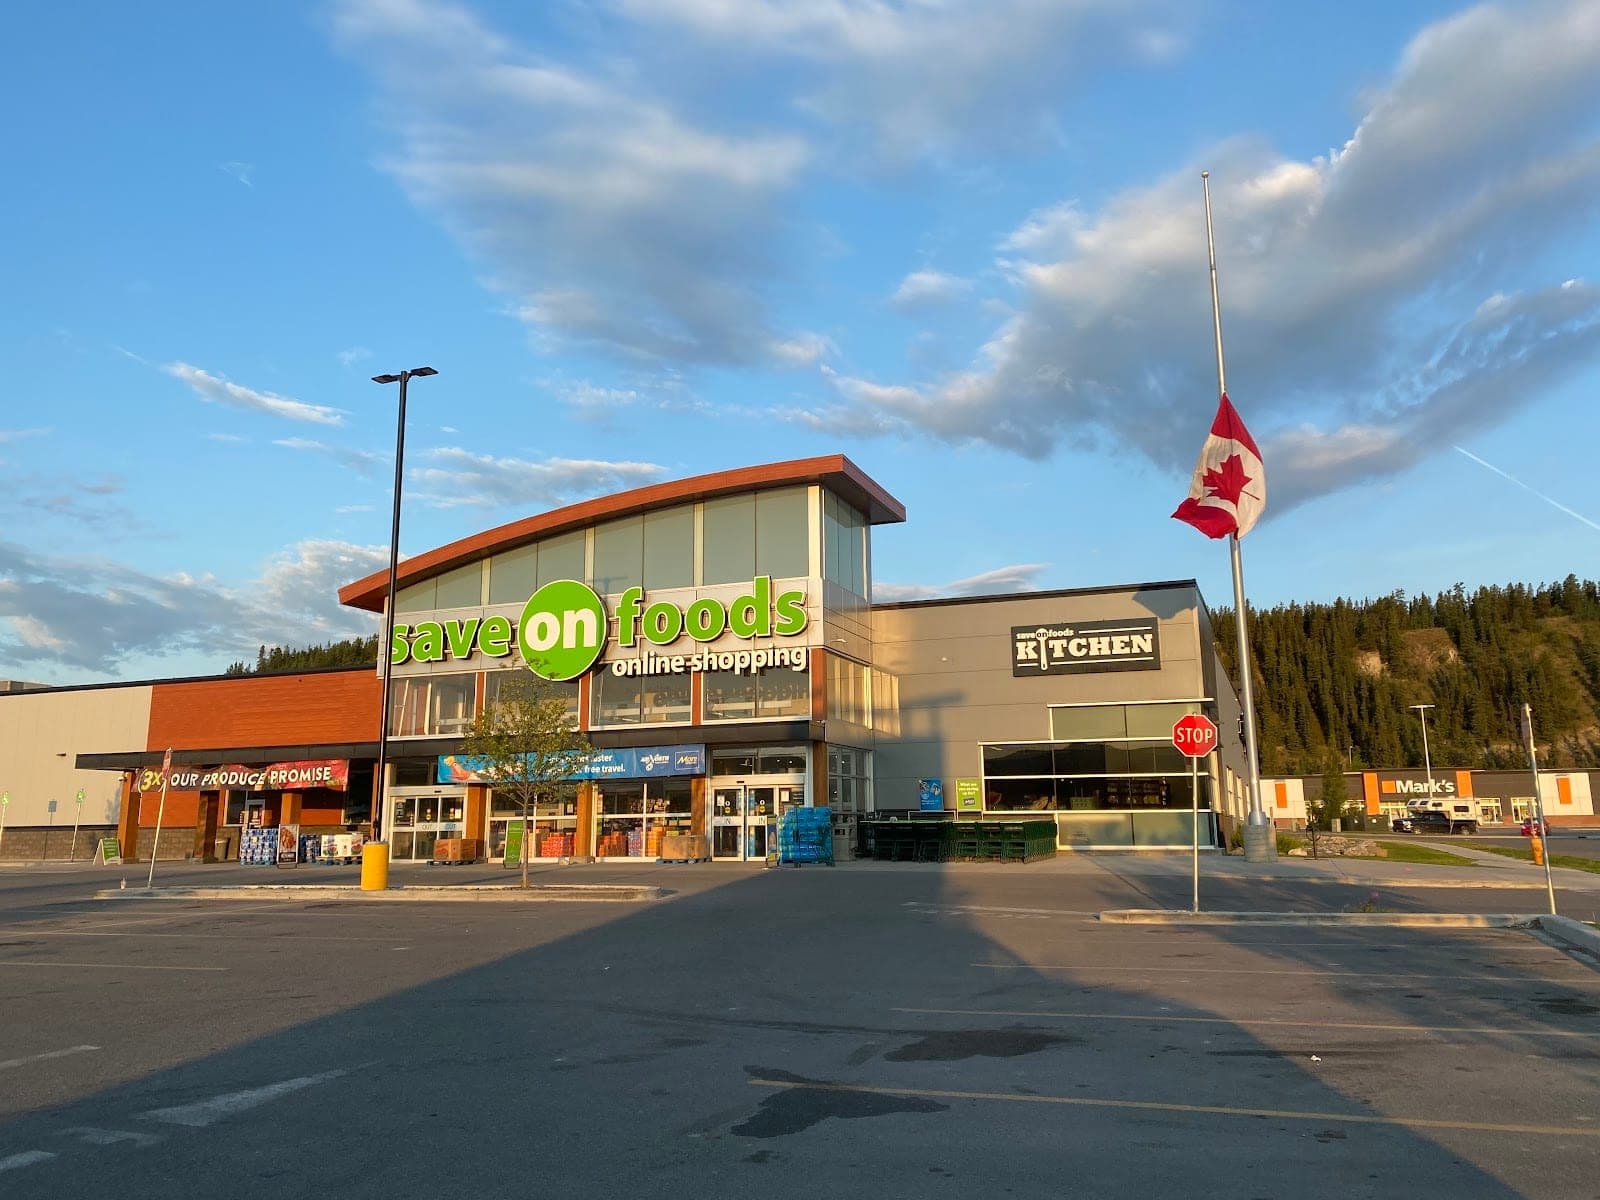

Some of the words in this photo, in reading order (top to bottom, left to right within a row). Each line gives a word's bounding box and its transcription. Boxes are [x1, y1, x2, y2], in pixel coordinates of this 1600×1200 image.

[392, 615, 512, 664] save
[524, 605, 598, 652] on
[615, 575, 809, 648] foods
[1016, 632, 1036, 640] save
[1047, 627, 1075, 638] foods
[611, 651, 685, 677] online
[691, 642, 807, 675] shopping
[1176, 727, 1213, 744] STOP
[590, 753, 613, 763] aster
[584, 765, 601, 774] free
[602, 762, 626, 774] travel.
[170, 773, 199, 787] OUR
[201, 771, 266, 786] PRODUCE
[270, 766, 332, 784] PROMISE
[1395, 779, 1456, 794] Mark's
